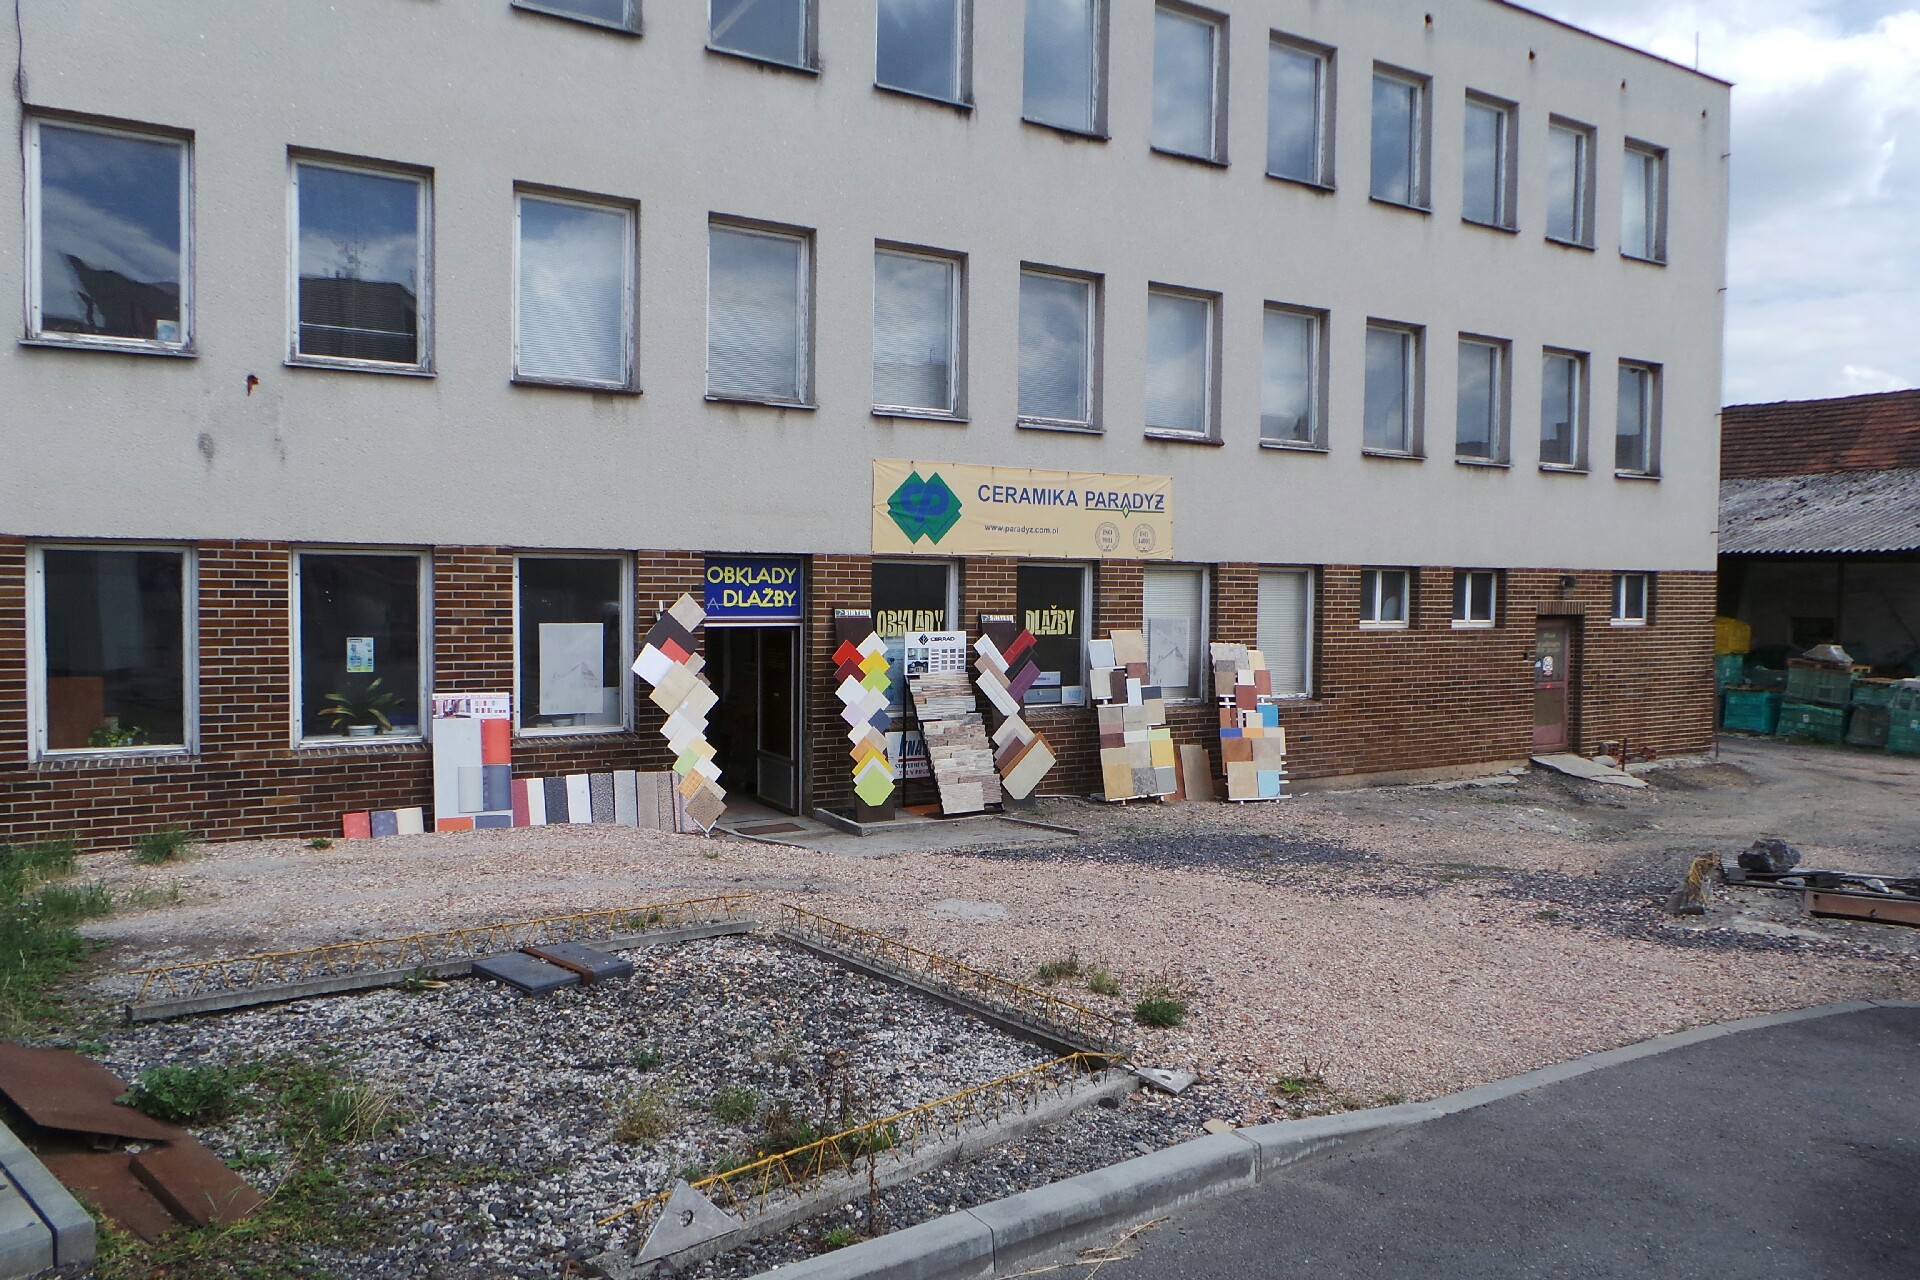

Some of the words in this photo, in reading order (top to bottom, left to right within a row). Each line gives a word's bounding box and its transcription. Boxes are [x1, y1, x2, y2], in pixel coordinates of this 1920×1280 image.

[977, 484, 1079, 507] CERAMIKA
[984, 524, 1059, 535] www.paradyz.com.pl
[706, 566, 797, 586] OBKLADY
[876, 610, 945, 638] OBKLADY
[1025, 605, 1075, 635] DLAŽBY
